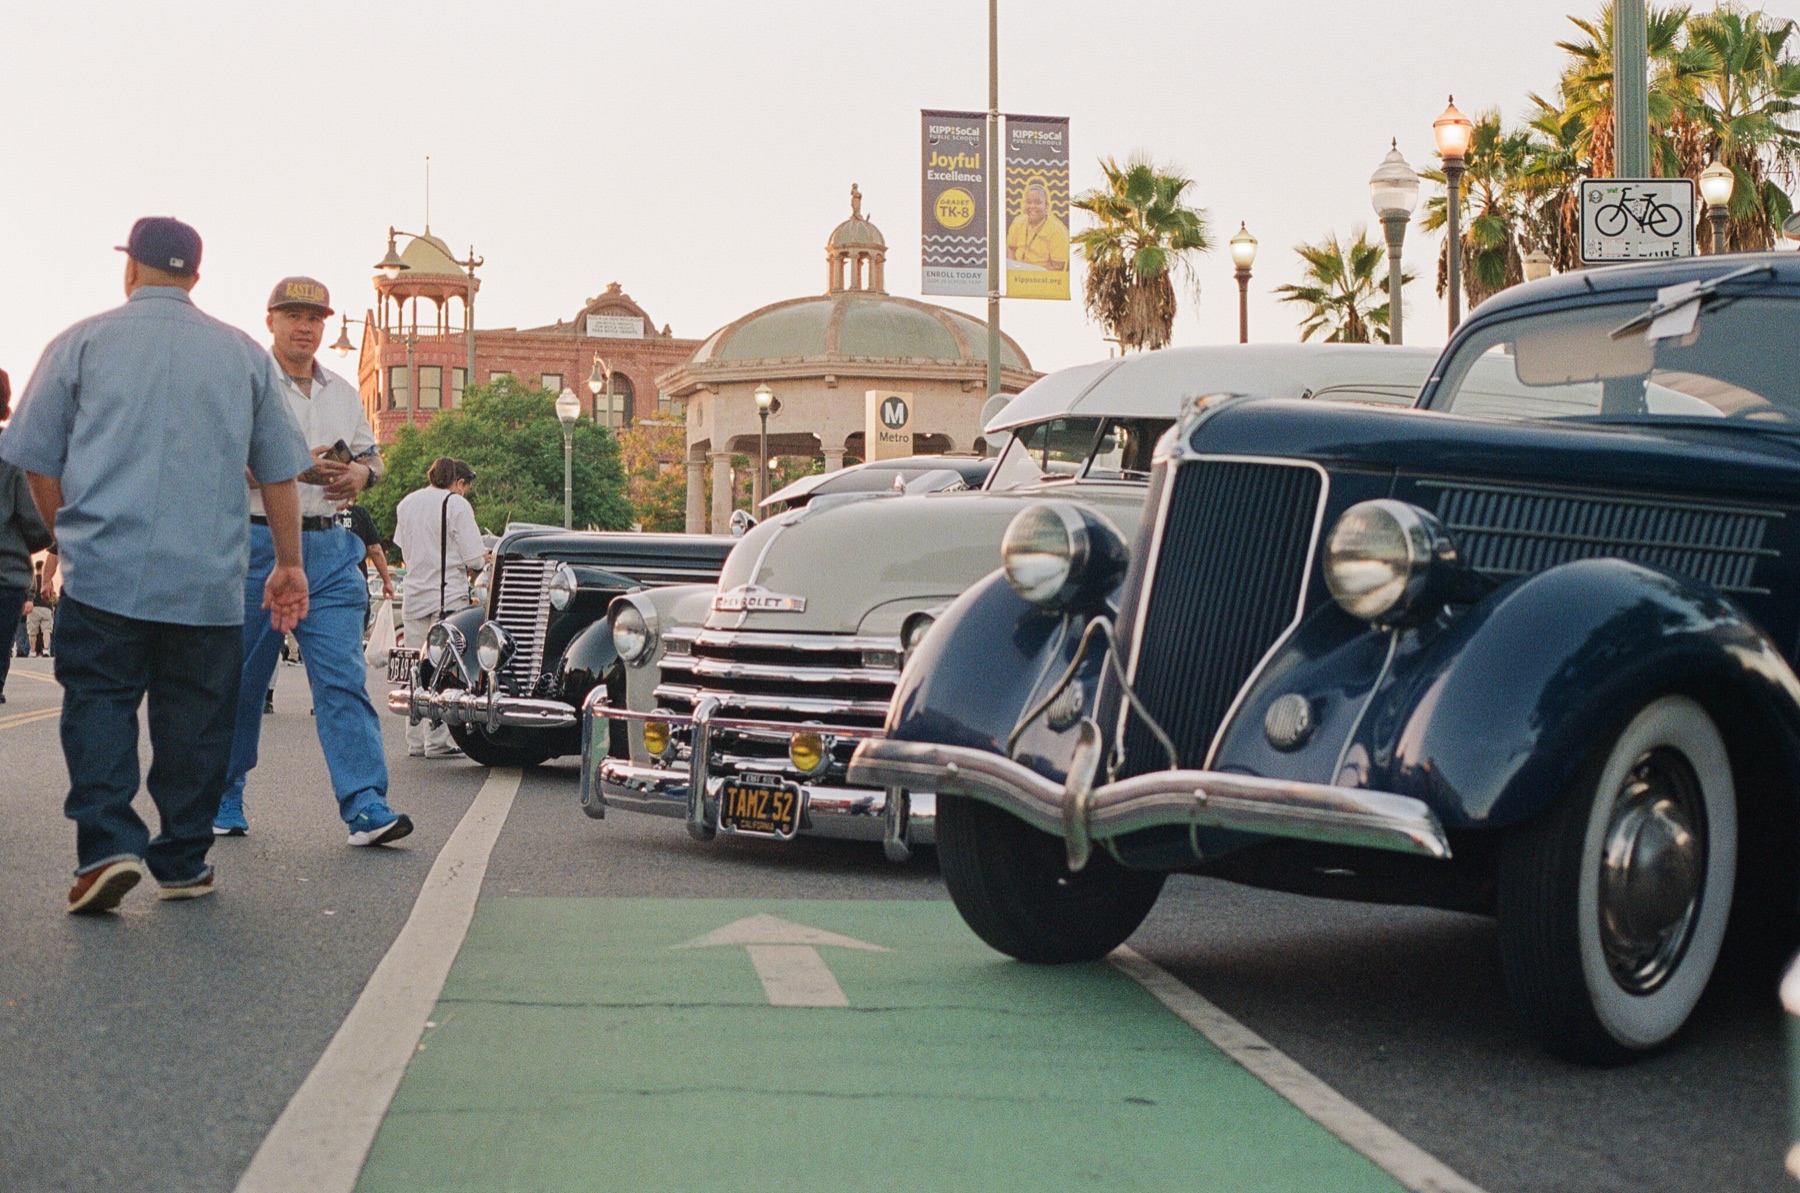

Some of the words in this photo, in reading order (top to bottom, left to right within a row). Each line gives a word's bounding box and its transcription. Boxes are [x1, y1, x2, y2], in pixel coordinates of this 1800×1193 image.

[929, 151, 980, 171] Joyful
[927, 170, 982, 183] Excellence
[939, 206, 970, 219] TK-8
[1014, 276, 1062, 286] kippsocal.org
[285, 282, 311, 298] EAST
[879, 431, 909, 443] Metro
[716, 597, 782, 607] CHEVROLET
[728, 787, 770, 820] TAMZ
[772, 791, 794, 822] 52
